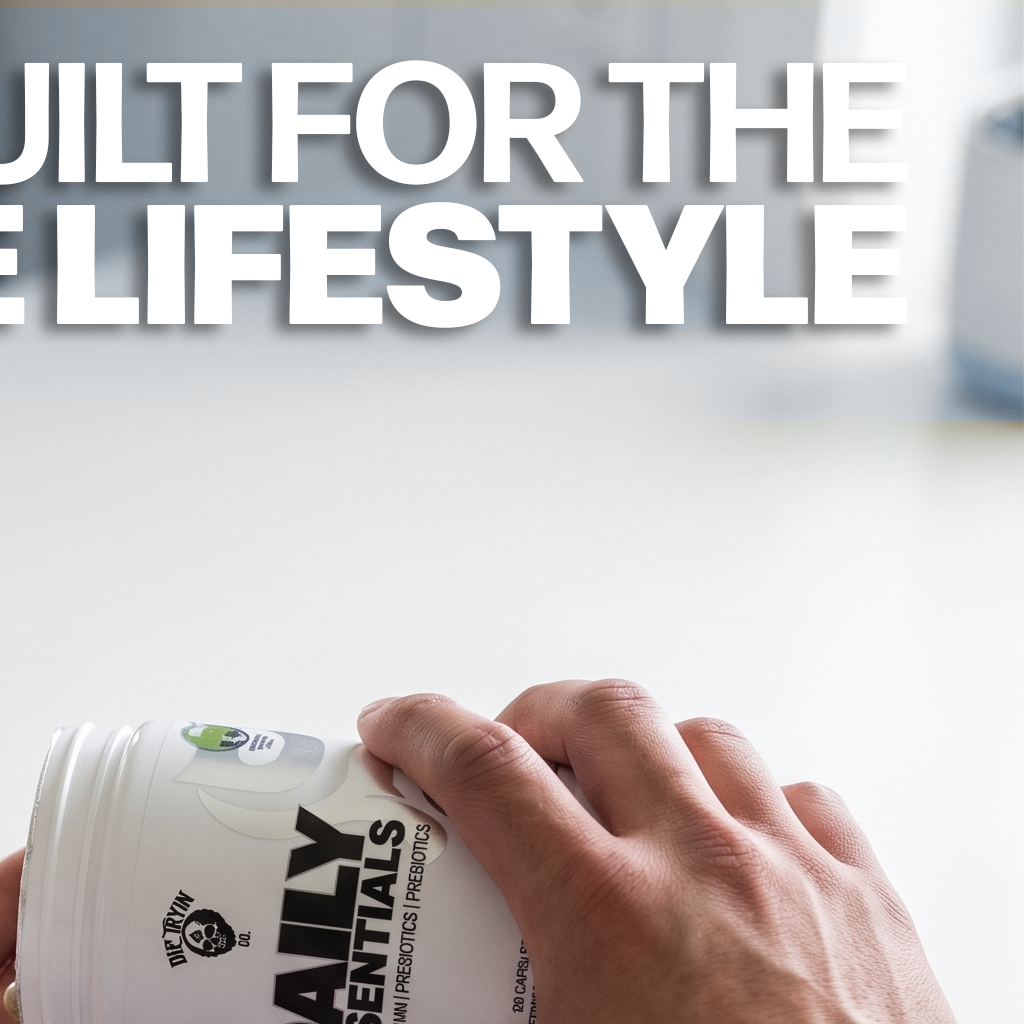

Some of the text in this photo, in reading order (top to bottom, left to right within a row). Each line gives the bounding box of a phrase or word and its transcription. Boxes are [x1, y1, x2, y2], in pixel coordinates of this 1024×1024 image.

[405, 823, 431, 902] PREBIOTICS
[161, 889, 196, 969] DIE TRYIN
